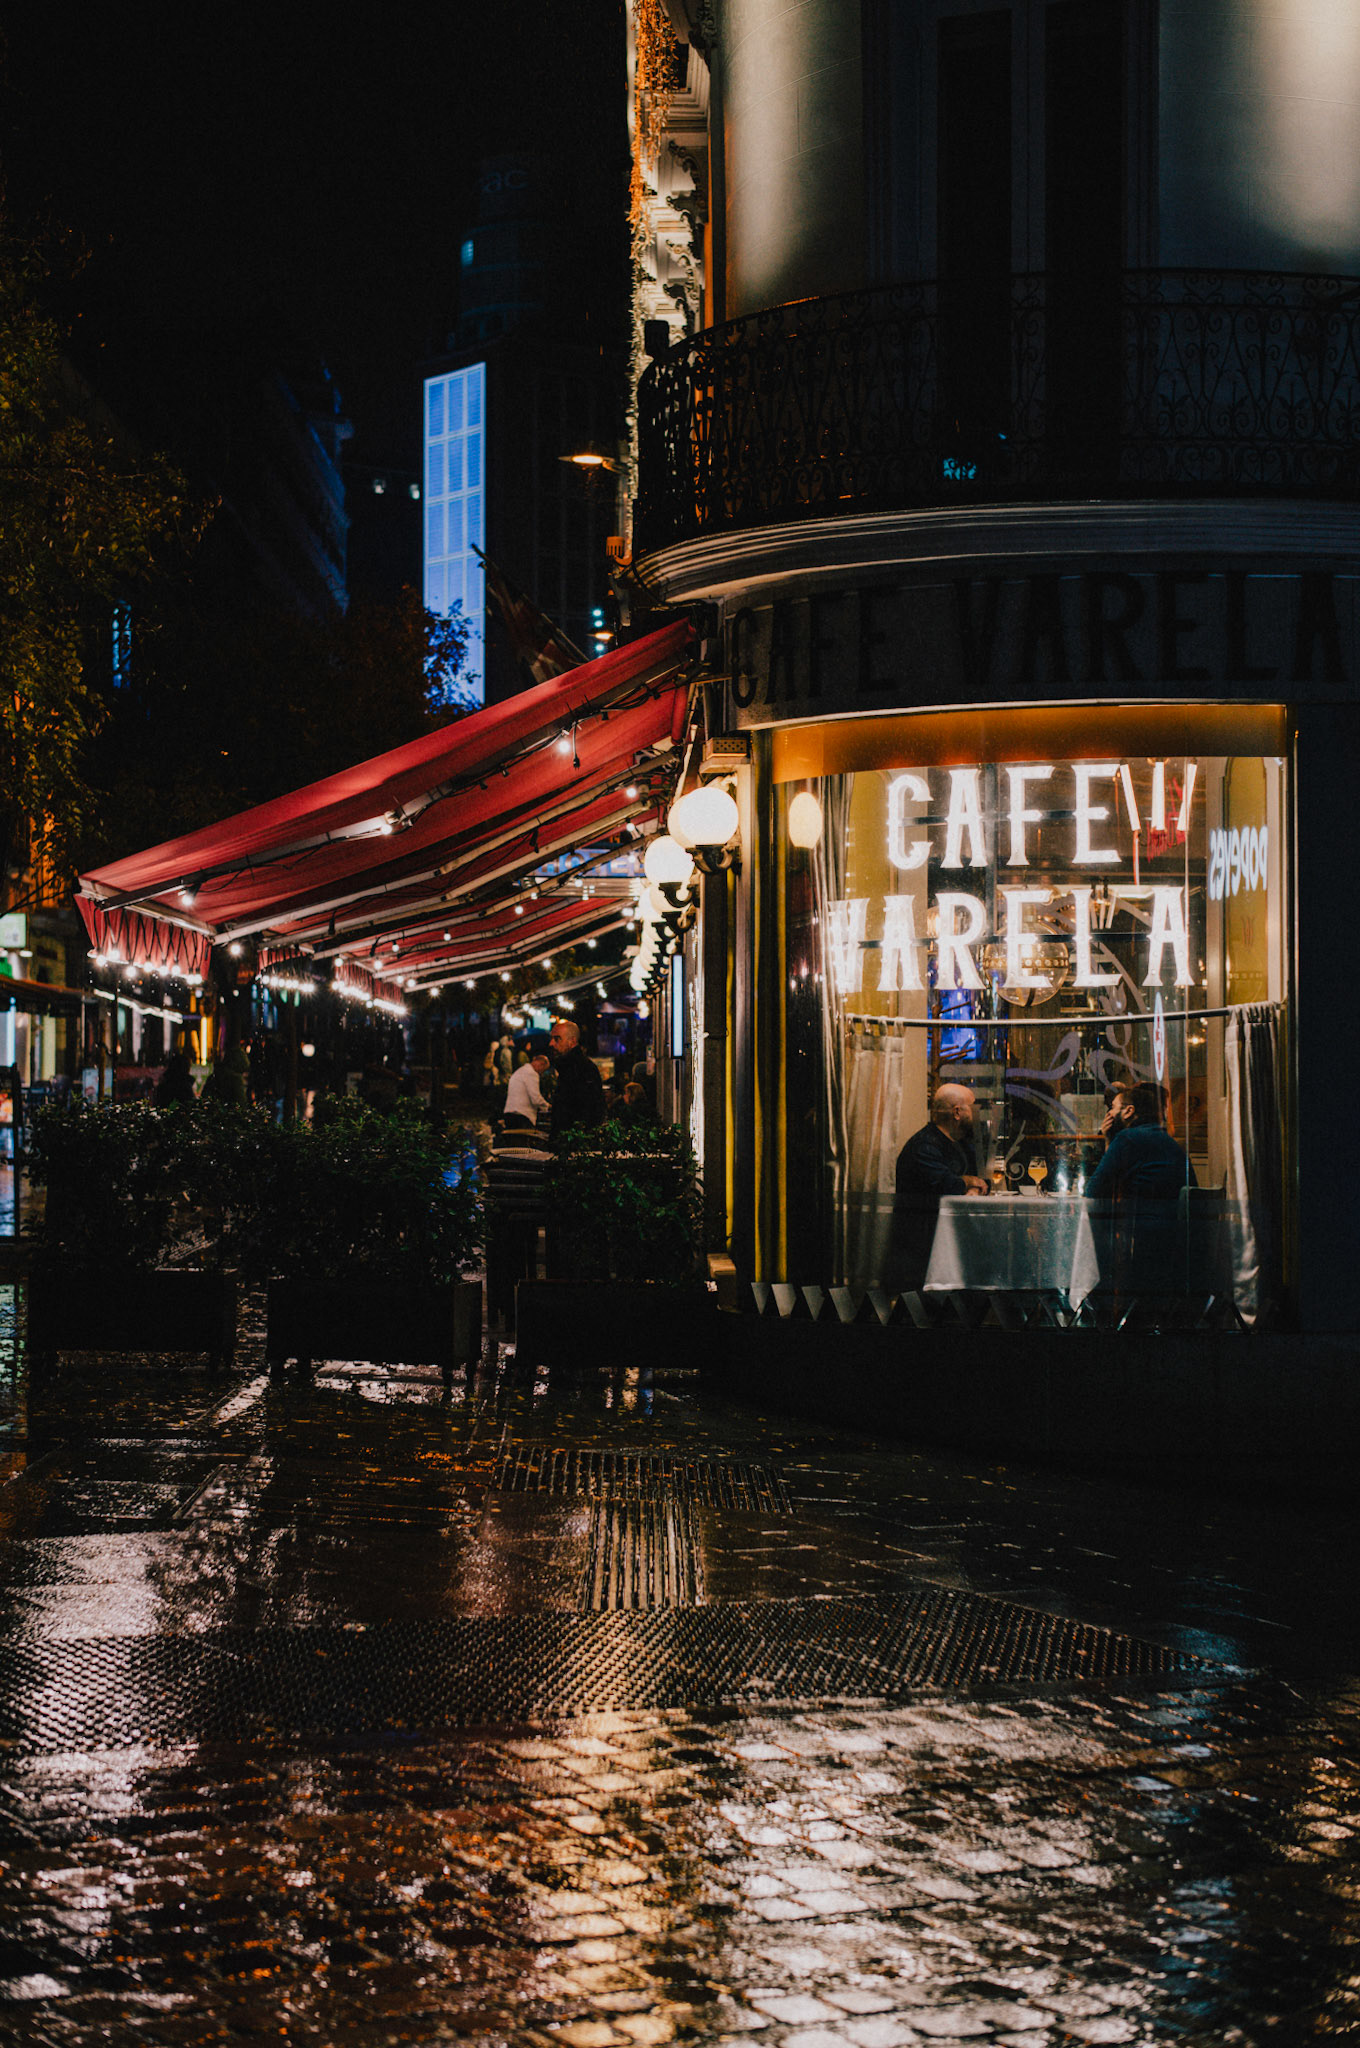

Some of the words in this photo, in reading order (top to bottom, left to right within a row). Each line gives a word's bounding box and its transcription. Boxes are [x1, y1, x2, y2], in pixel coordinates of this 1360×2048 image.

[731, 582, 898, 708] CAFE
[951, 570, 1348, 683] VARELA
[888, 763, 1123, 870] CAFE
[827, 886, 1196, 993] VARELA
